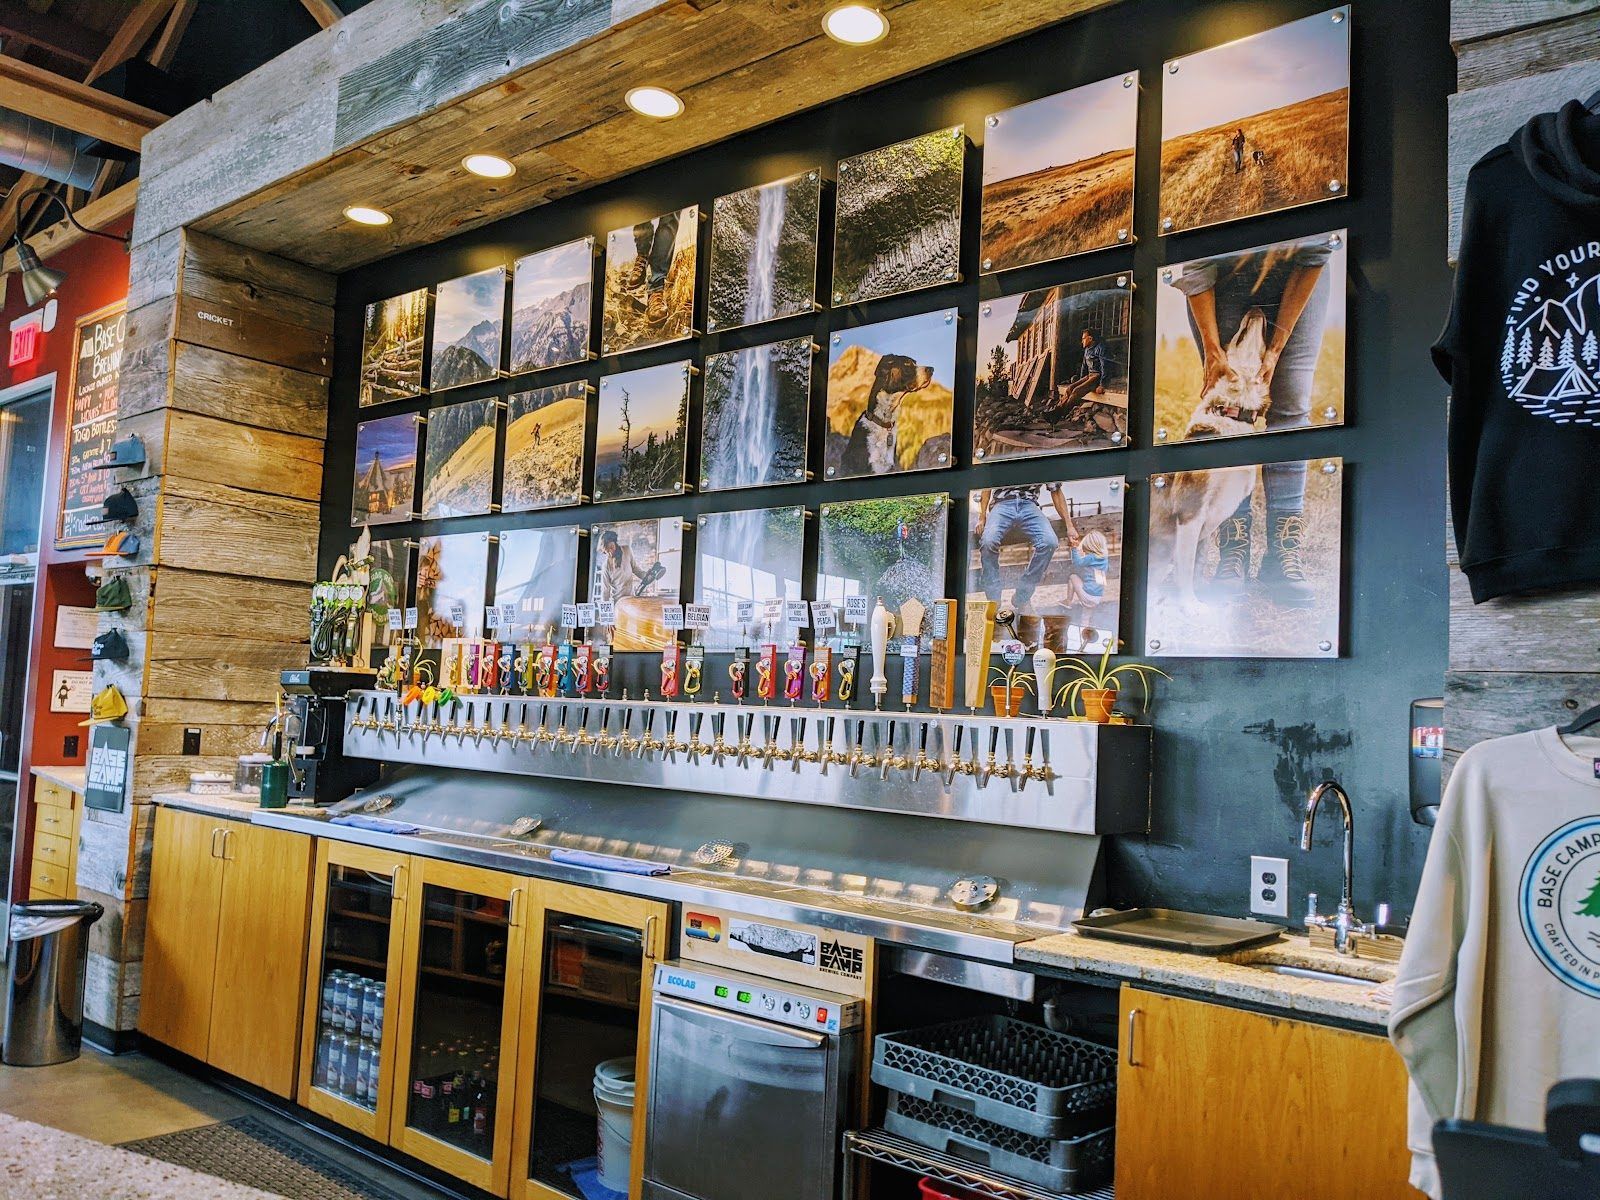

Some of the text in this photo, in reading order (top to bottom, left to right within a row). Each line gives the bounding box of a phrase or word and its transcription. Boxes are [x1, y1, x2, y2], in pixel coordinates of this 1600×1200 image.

[1506, 277, 1540, 325] FIND
[197, 311, 234, 327] CRICKET
[14, 327, 32, 361] EXIT
[562, 612, 576, 625] FEST
[687, 613, 709, 621] BELGIAN
[817, 617, 831, 626] PEACH
[92, 741, 126, 767] BASE
[89, 763, 125, 786] CAMP
[1537, 865, 1562, 908] BASE
[820, 938, 863, 959] BASE
[1544, 923, 1578, 967] CRAFTED
[1578, 964, 1591, 976] IN
[819, 951, 862, 973] CAMP
[667, 975, 696, 989] ECOLAB
[819, 967, 862, 980] BREWING COMPANY
